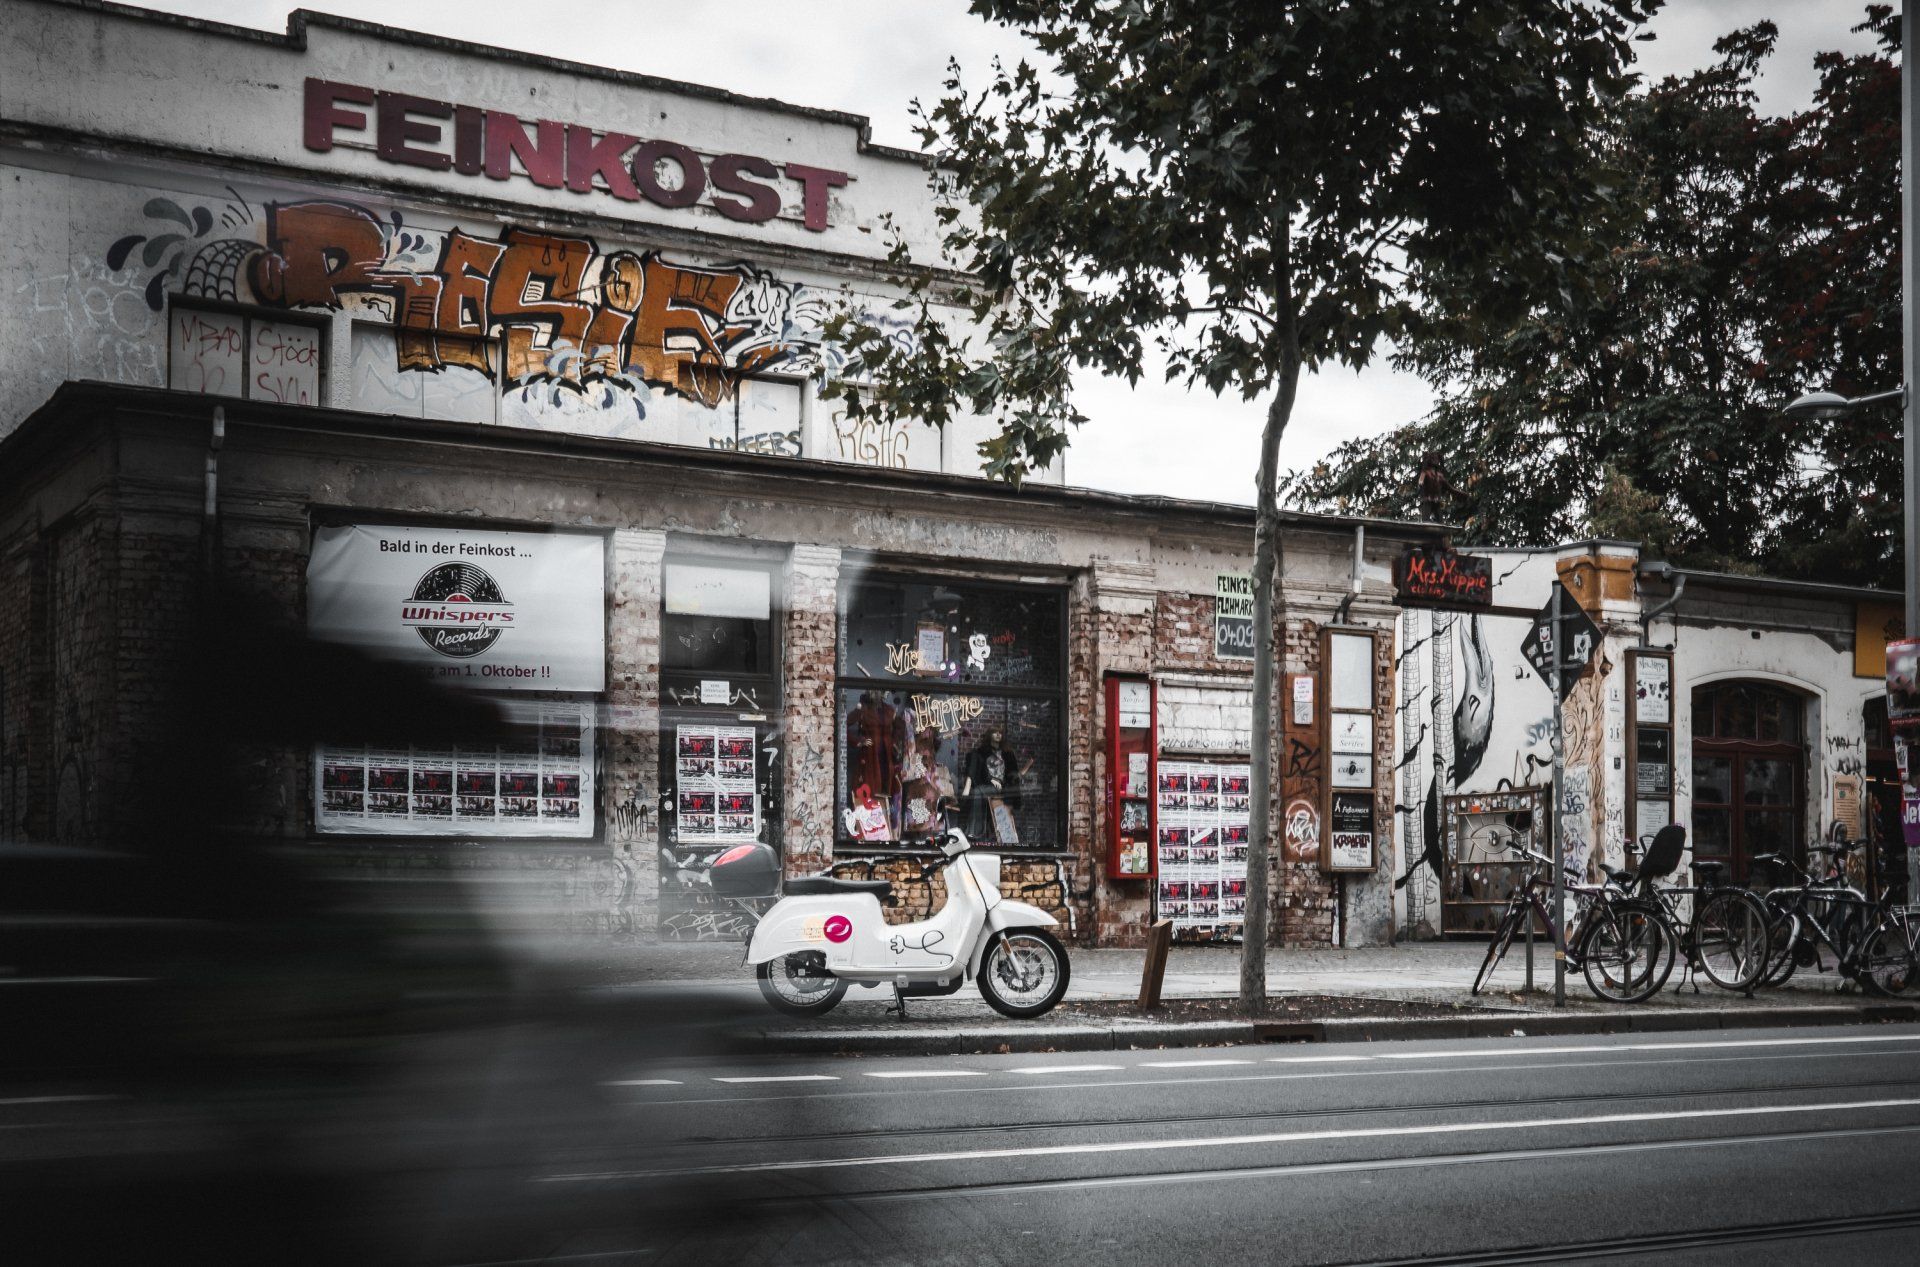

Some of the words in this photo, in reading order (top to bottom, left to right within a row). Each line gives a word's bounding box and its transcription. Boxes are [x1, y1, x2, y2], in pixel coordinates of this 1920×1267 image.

[304, 77, 848, 232] FEINKOST
[379, 540, 411, 553] Bald
[415, 541, 428, 554] in
[432, 542, 455, 555] der
[459, 543, 516, 557] Feinkost
[402, 606, 515, 623] Whispers
[1217, 596, 1253, 616] FLOHMARK
[435, 622, 490, 646] Records
[439, 667, 460, 677] am
[465, 665, 477, 677] 1.
[481, 665, 537, 678] Oktober
[541, 666, 551, 678] !!
[912, 695, 983, 733] Hippie
